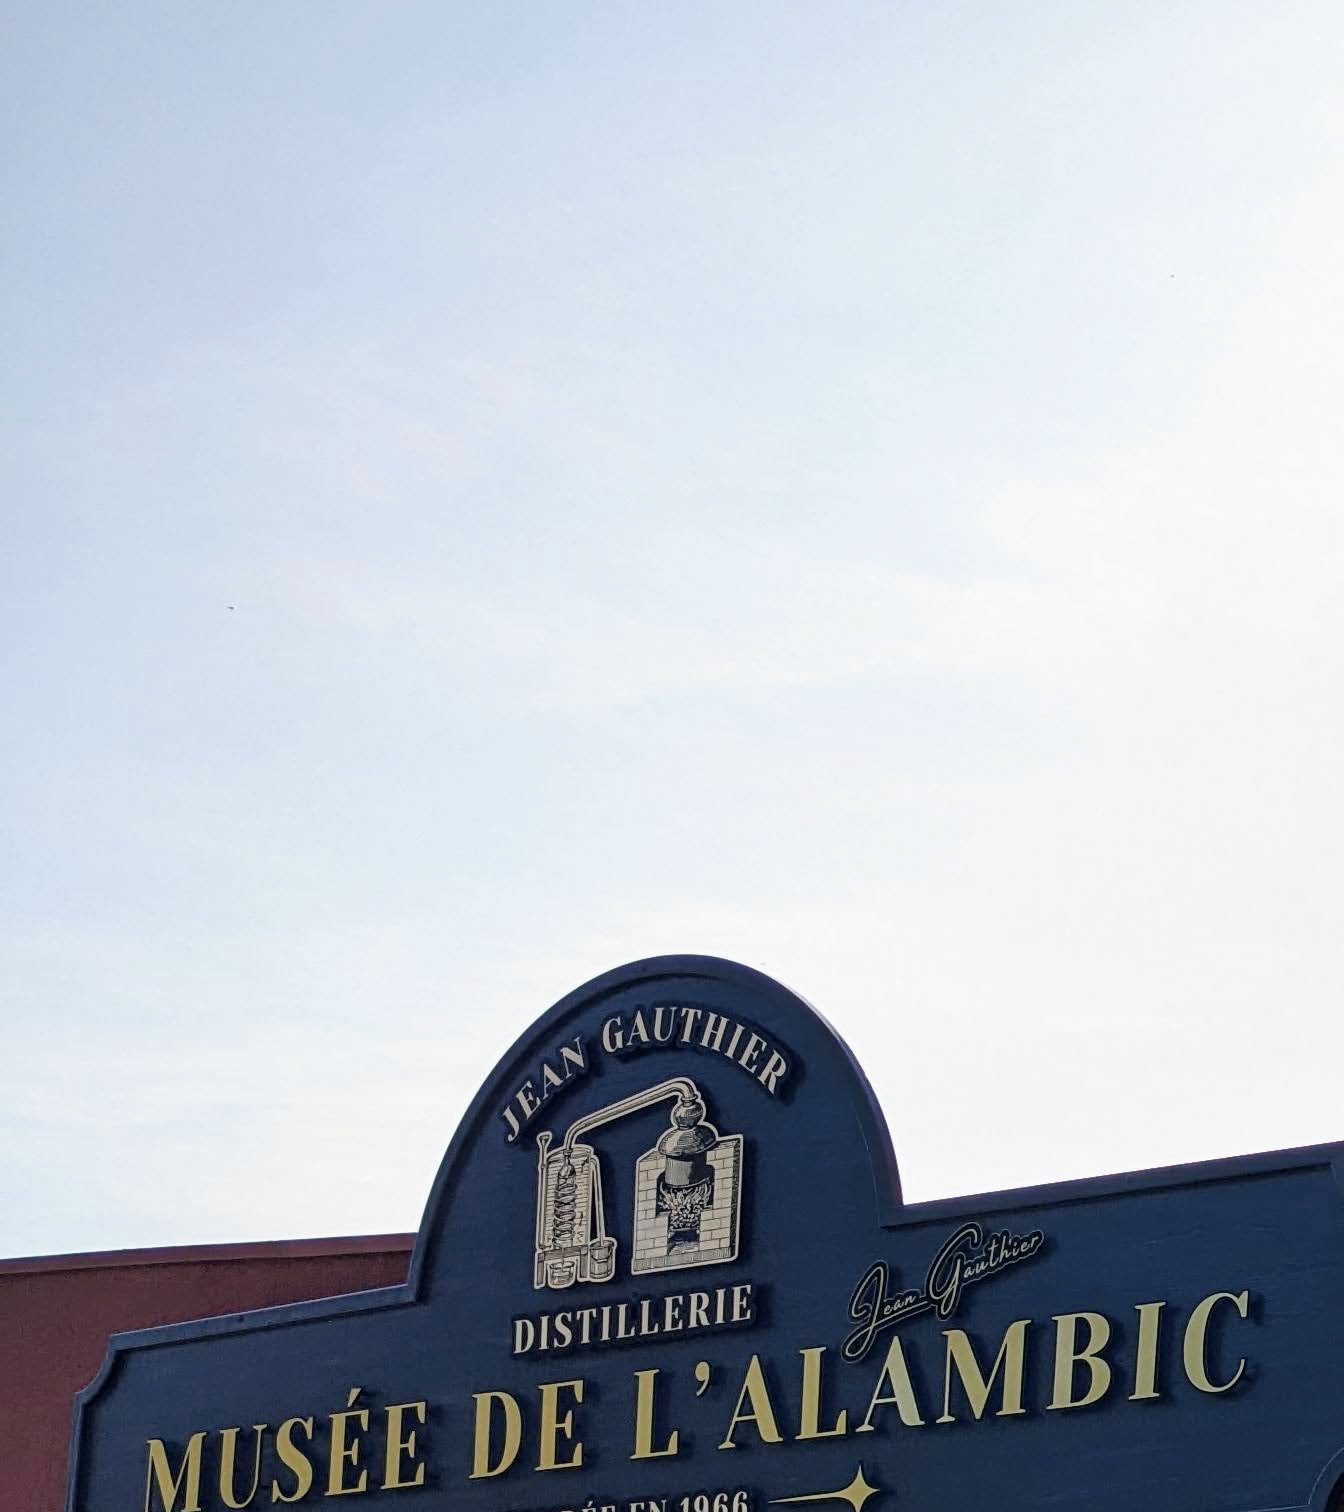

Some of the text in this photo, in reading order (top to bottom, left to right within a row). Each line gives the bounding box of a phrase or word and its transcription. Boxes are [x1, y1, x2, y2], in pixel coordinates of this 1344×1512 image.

[503, 1007, 788, 1142] JEAN GAUTHIER
[513, 1284, 751, 1354] DISTILLERIE
[845, 1228, 1039, 1357] Jean Gauthier
[468, 1380, 584, 1479] DE
